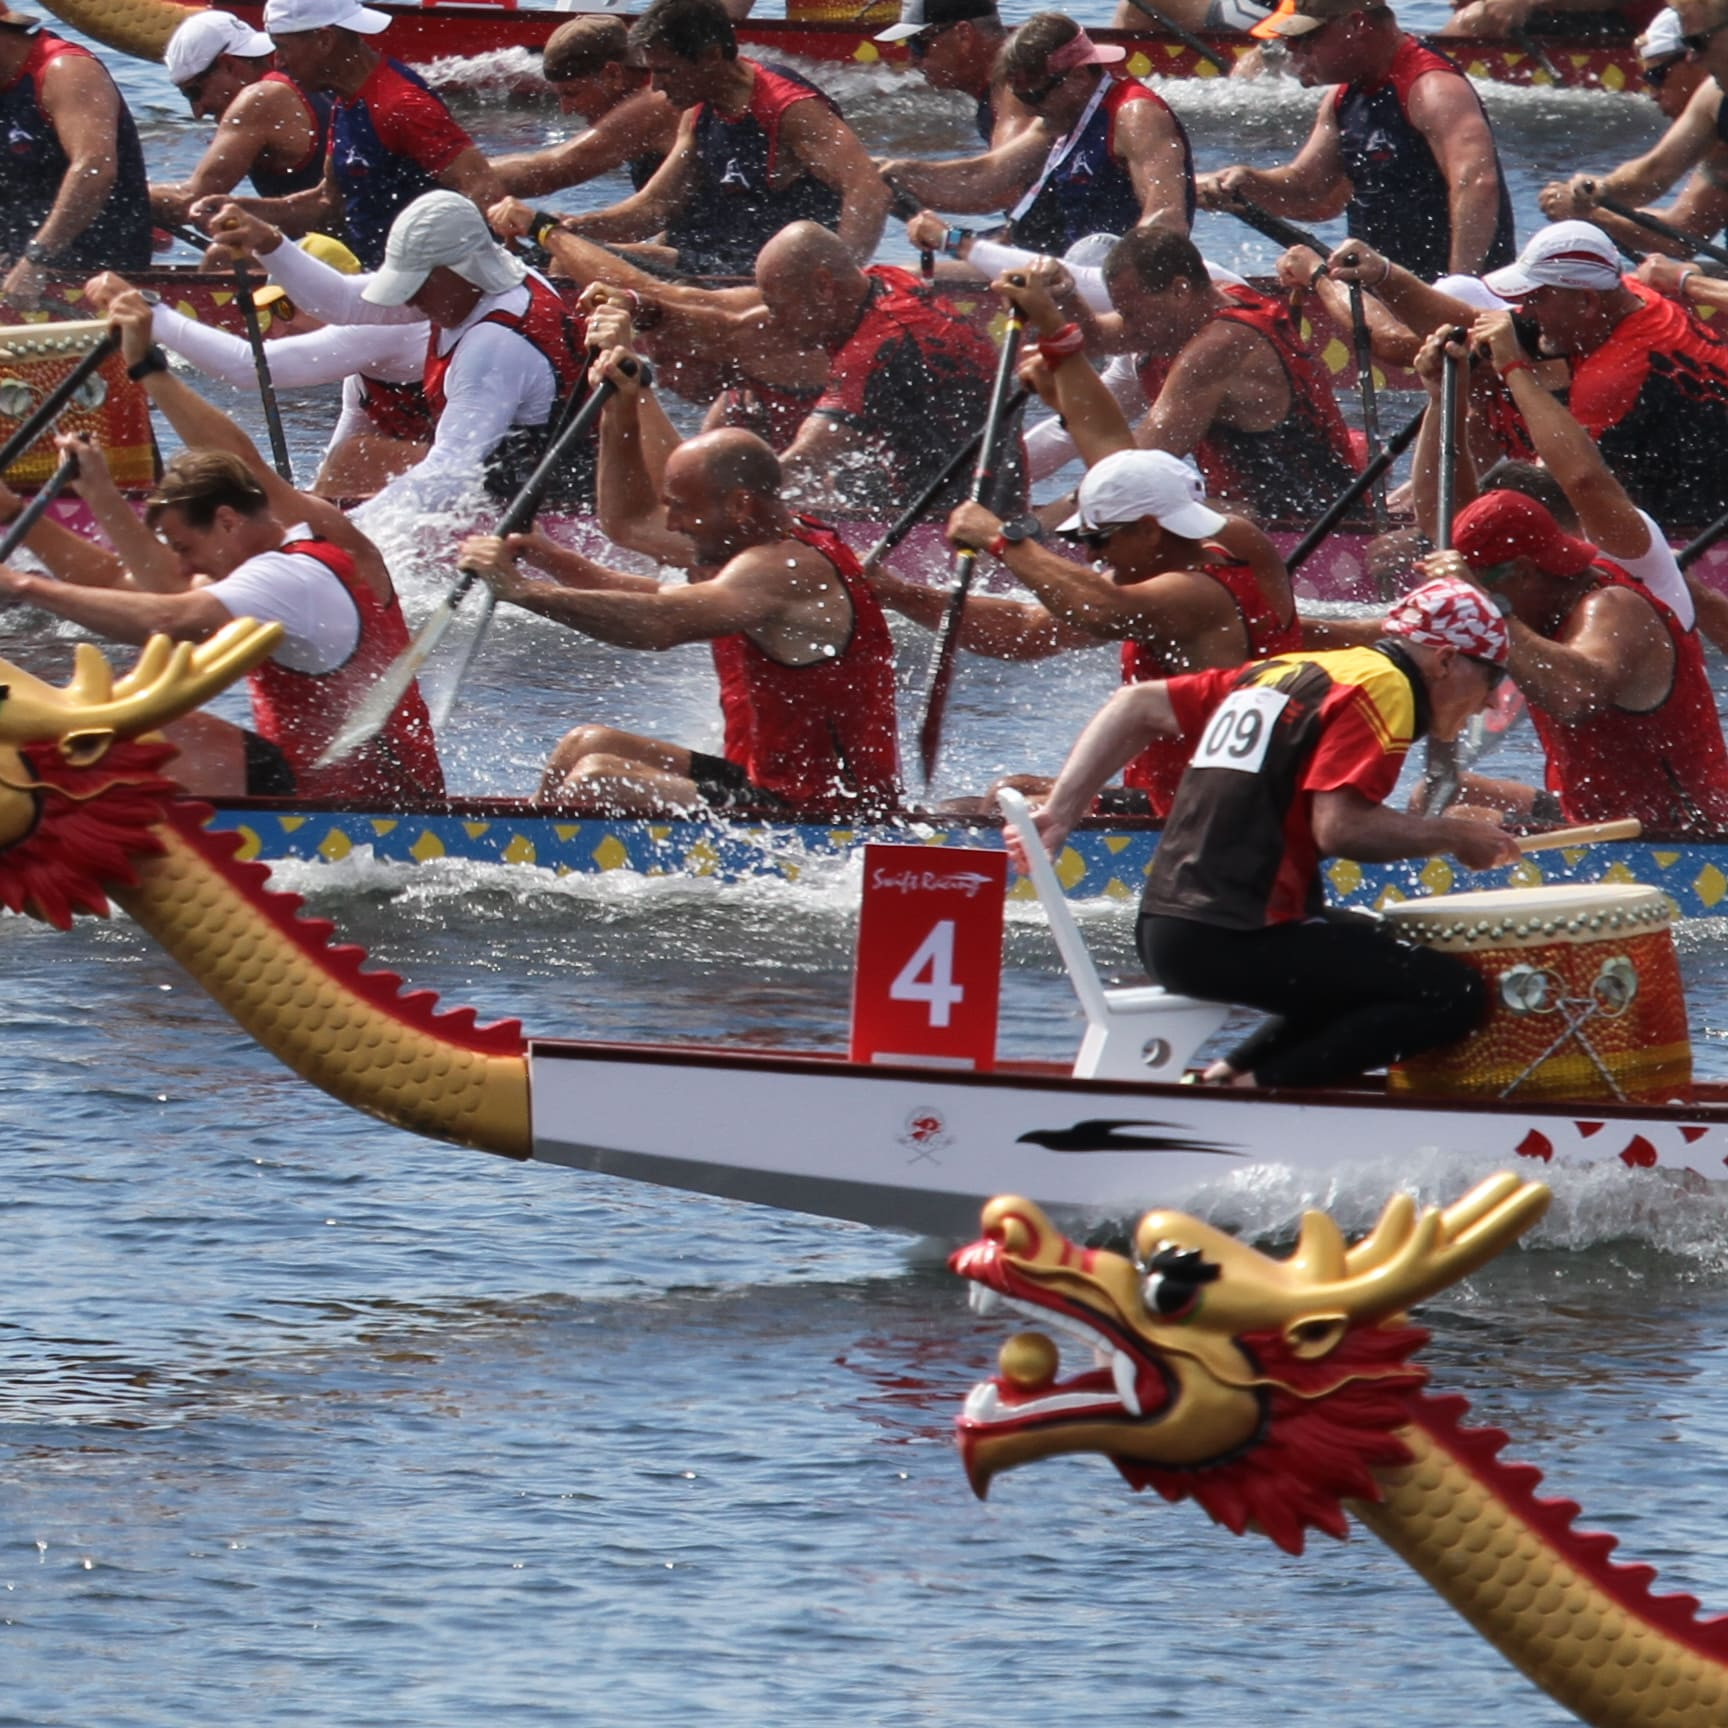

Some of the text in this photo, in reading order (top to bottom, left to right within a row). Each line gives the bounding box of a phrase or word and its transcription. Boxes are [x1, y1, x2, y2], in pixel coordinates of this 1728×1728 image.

[1205, 707, 1264, 760] 09
[871, 868, 981, 898] Swift Racing
[888, 920, 965, 1028] 4
